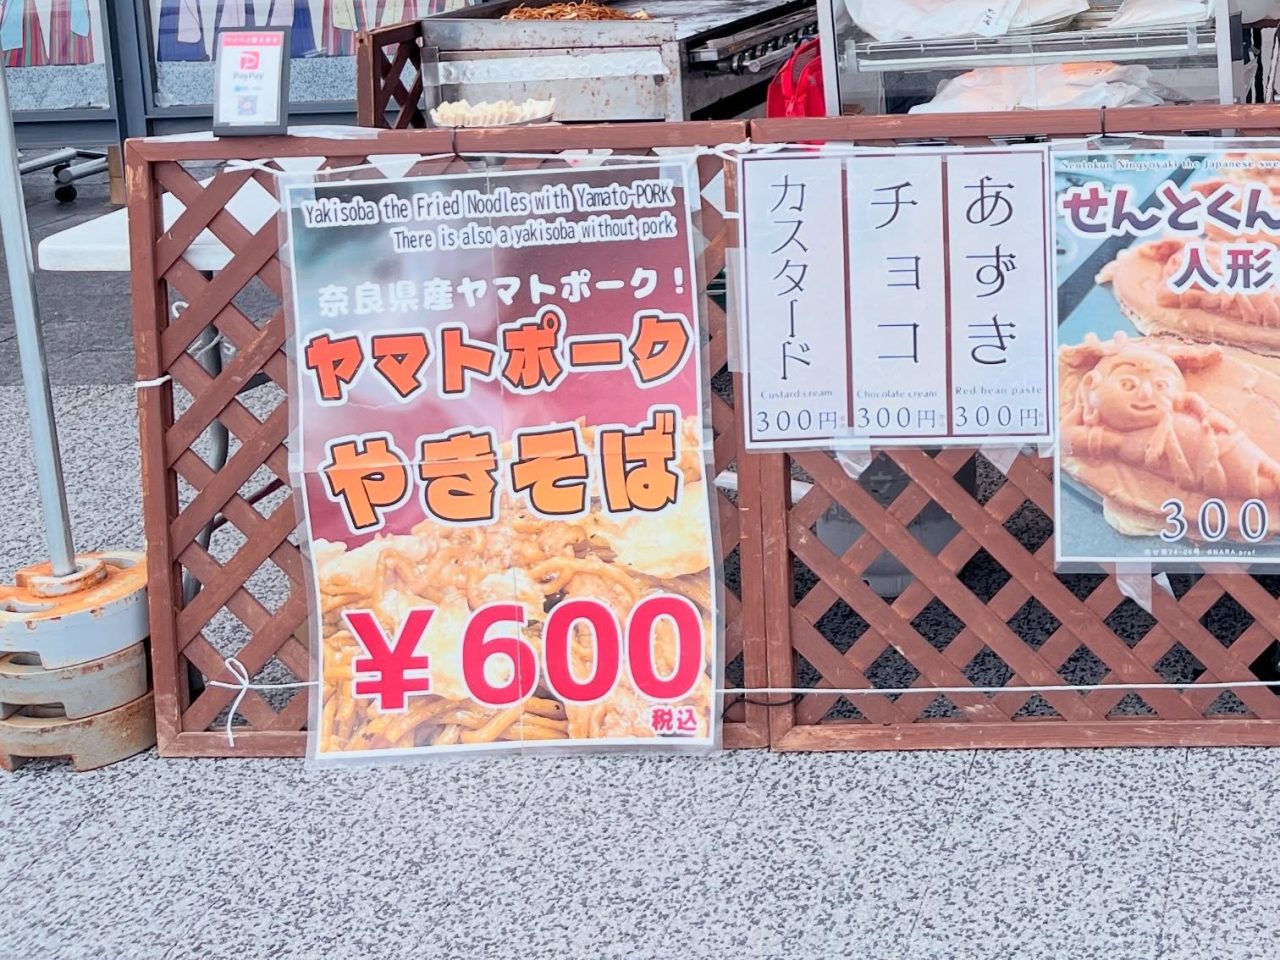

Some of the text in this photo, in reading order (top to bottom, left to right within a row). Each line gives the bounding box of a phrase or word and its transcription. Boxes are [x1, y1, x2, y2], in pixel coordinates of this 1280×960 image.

[305, 184, 671, 224] Yakisoba the Fried Noodles with Yamato-PORK
[394, 217, 672, 251] There is also a yakisoba without pork
[771, 174, 811, 380] カスタード
[871, 181, 921, 363] チョコ
[964, 176, 1018, 365] あずき
[306, 312, 690, 400] ヤマトポーク
[756, 408, 837, 433] 300円
[857, 406, 936, 431] 300円
[956, 404, 1038, 428] 300円
[326, 410, 678, 529] やきそば
[346, 596, 702, 711] ¥600
[651, 708, 698, 732] 税込
